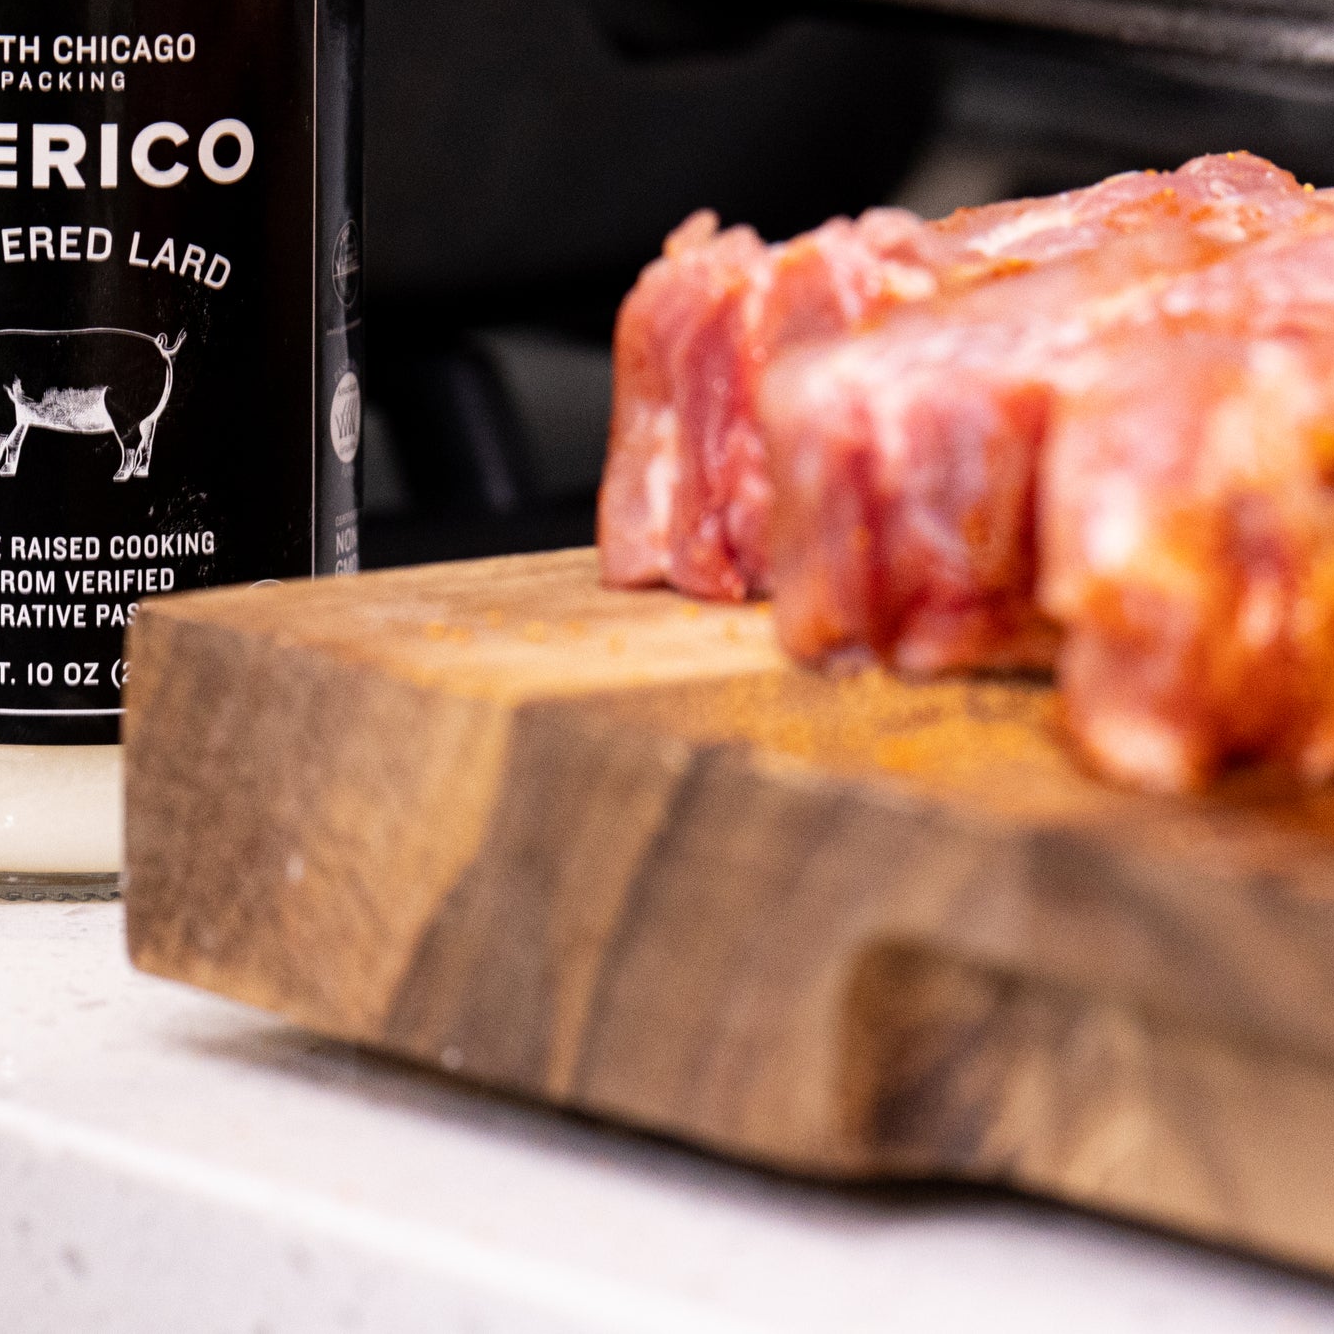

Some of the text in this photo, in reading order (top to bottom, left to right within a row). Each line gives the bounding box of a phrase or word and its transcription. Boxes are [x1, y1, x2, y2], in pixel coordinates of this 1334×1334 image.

[52, 32, 197, 65] CHICAGO
[0, 69, 126, 92] PACKING
[128, 231, 232, 291] LARD
[10, 535, 101, 561] RAISED
[108, 530, 216, 560] COOKING
[64, 566, 175, 594] VERIFIED
[96, 602, 140, 628] PAS
[27, 661, 54, 687] 10
[63, 661, 100, 687] OZ
[110, 658, 131, 690] (2
